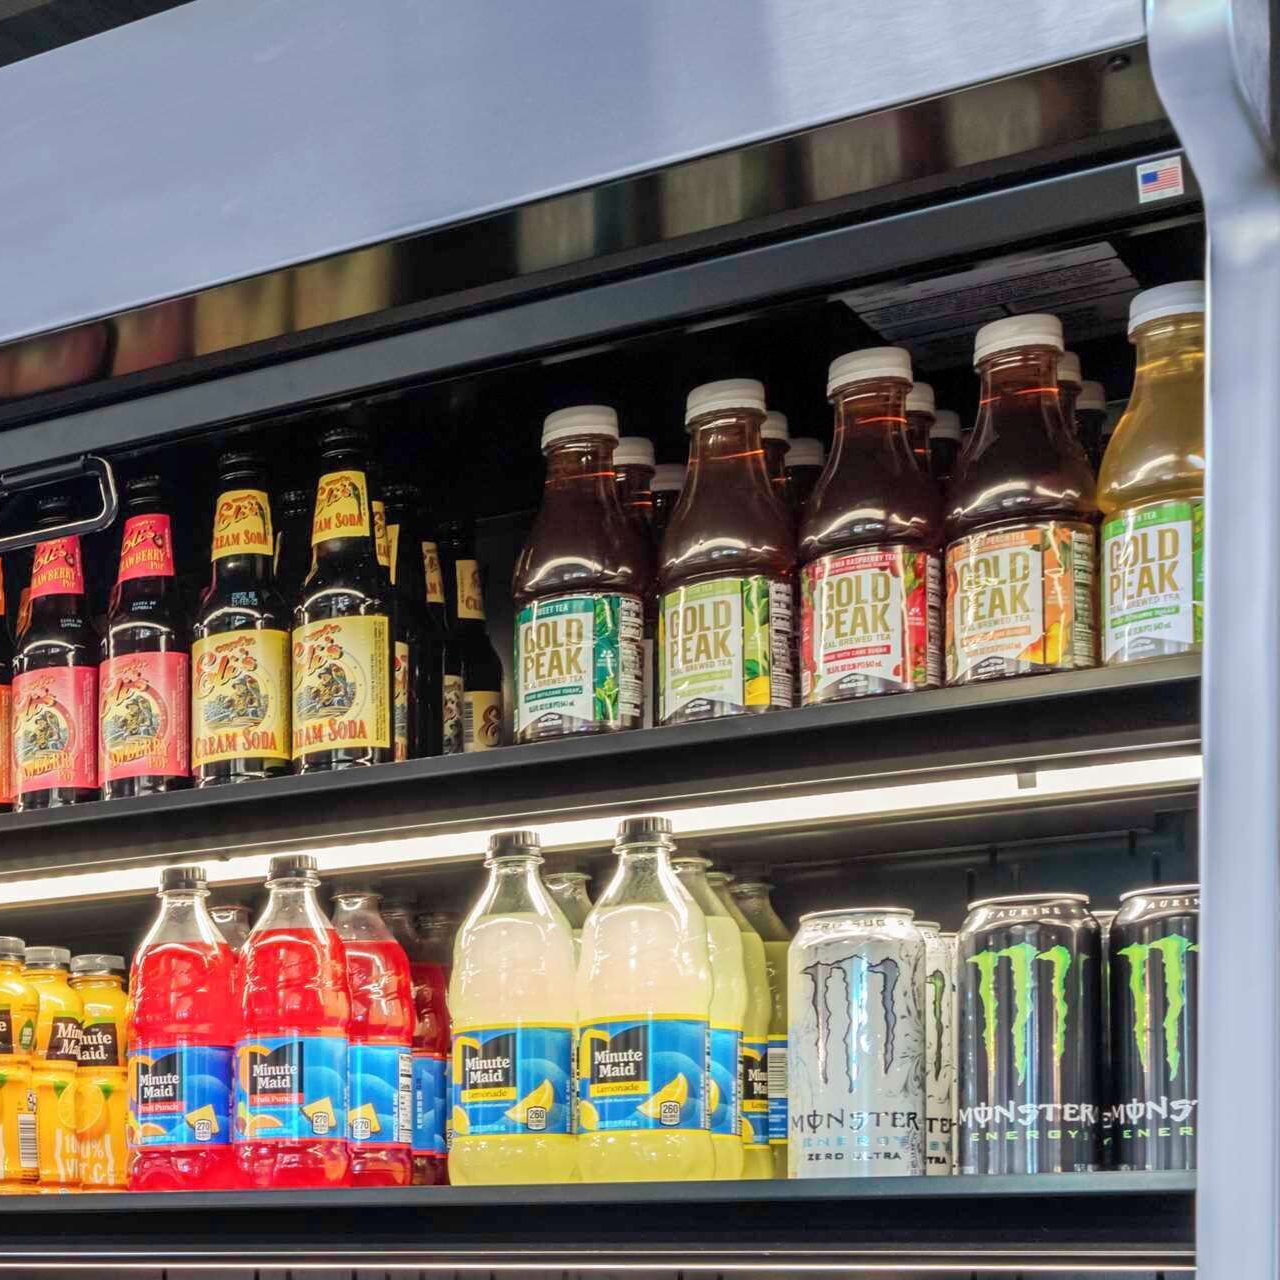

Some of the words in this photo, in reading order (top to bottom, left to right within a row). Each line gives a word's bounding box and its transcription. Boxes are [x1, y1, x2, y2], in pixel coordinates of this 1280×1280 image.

[1109, 527, 1181, 570] GOLD
[958, 550, 1031, 590] GOLD
[1108, 560, 1181, 604] PEAK
[825, 571, 891, 608] GOLD
[959, 583, 1031, 623] PEAK
[669, 599, 732, 641] GOLD
[821, 602, 890, 640] PEAK
[524, 617, 585, 655] GOLD
[670, 633, 732, 671] PEAK
[524, 648, 582, 684] PEAK
[327, 717, 368, 741] SODA
[195, 732, 238, 757] CREAM
[242, 729, 277, 751] SODA
[987, 906, 1062, 920] TAURINE
[465, 1056, 510, 1070] Minute
[594, 1050, 643, 1064] Minute
[252, 1064, 298, 1078] Minute
[469, 1069, 505, 1083] Maid
[598, 1063, 636, 1077] Maid
[139, 1073, 180, 1087] Minute
[257, 1076, 291, 1090] Maid
[143, 1085, 174, 1098] Maid
[467, 1089, 508, 1099] Lemonade
[596, 1083, 640, 1094] Lemonade
[529, 1110, 545, 1120] 260
[662, 1104, 679, 1115] 260
[959, 1101, 1096, 1126] MONSTER
[314, 1113, 328, 1124] 270
[353, 1120, 369, 1131] 270
[792, 1110, 920, 1131] MONSTER
[196, 1121, 210, 1131] 270
[970, 1130, 1079, 1143] ENERGY
[807, 1153, 845, 1162] ZERO
